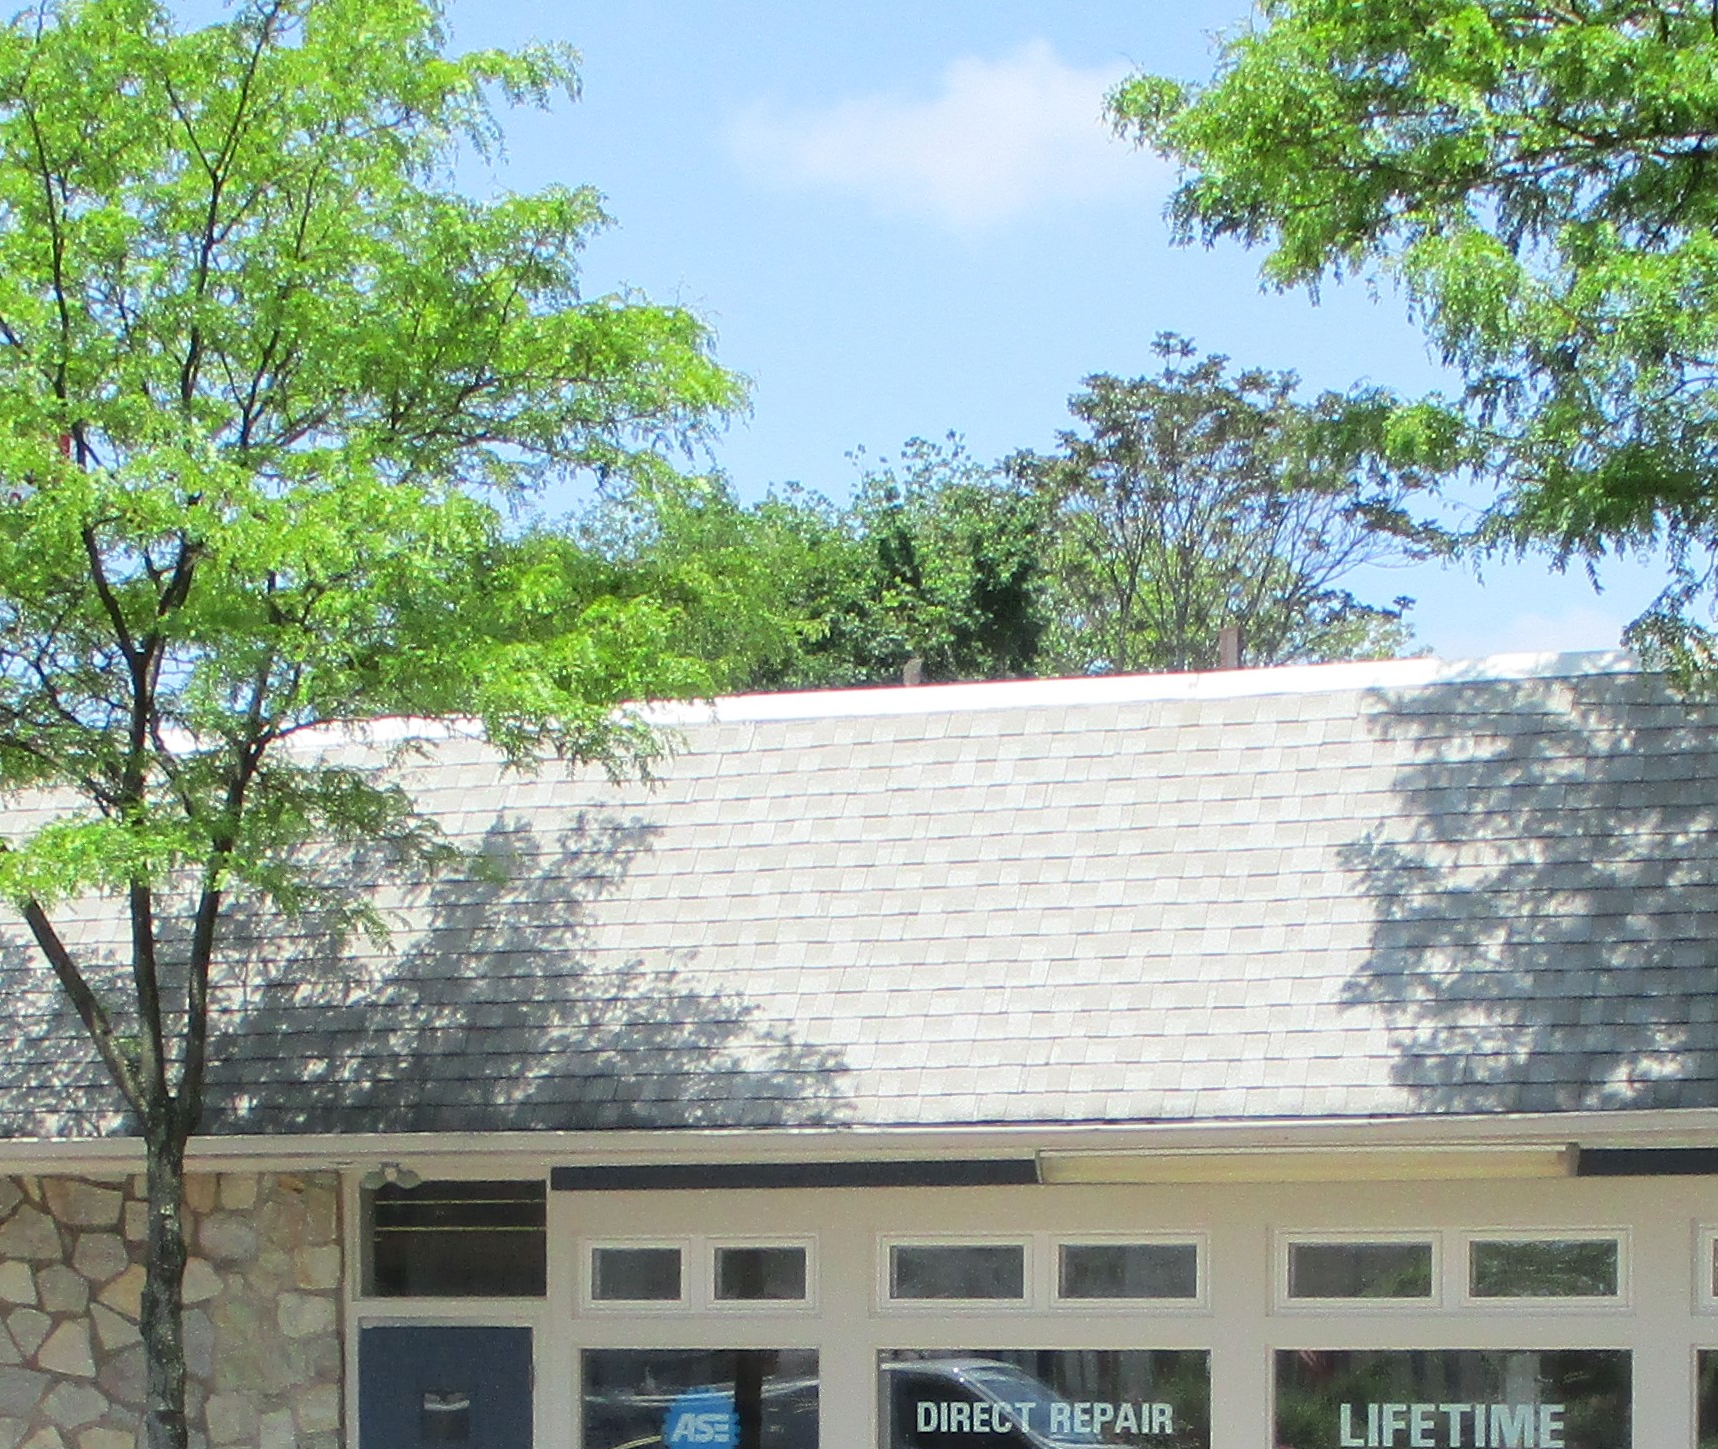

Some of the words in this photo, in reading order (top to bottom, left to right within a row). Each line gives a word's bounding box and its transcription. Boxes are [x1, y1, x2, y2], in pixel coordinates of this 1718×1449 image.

[671, 1413, 730, 1443] ASE
[916, 1401, 1036, 1434] DIRECT
[1050, 1402, 1174, 1434] REPAIR
[1339, 1402, 1566, 1449] LIFETIME
